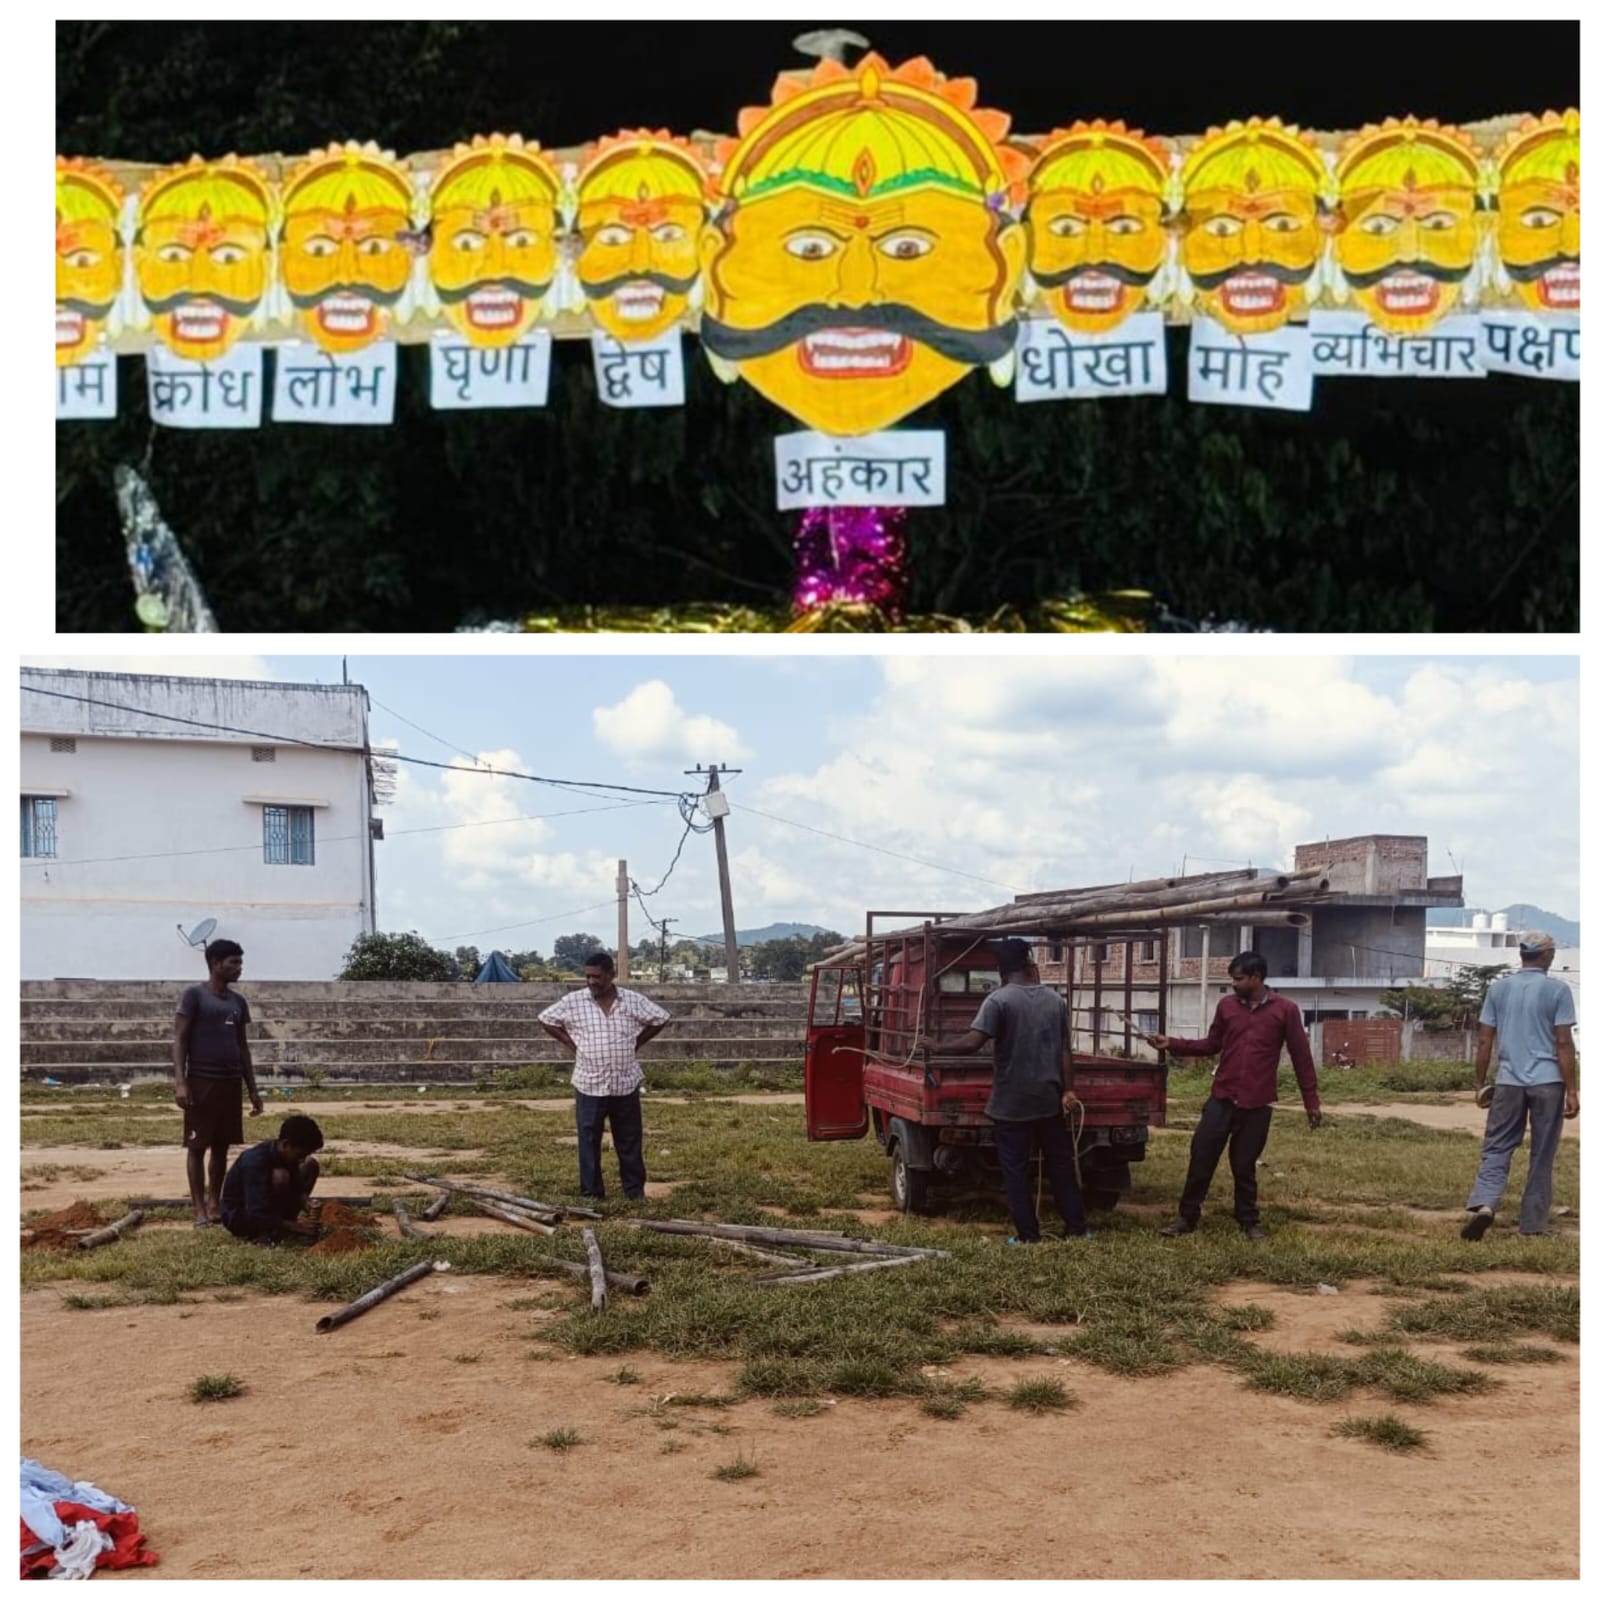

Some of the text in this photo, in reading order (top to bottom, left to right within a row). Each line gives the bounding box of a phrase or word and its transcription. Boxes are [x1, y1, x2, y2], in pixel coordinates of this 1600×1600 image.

[440, 344, 536, 400] घृणा
[598, 335, 670, 399] द्वेष
[1021, 329, 1155, 389] धोखा
[1195, 335, 1290, 400] मोह
[1310, 323, 1476, 371] व्यभिचार
[284, 351, 386, 407] लोभ
[782, 445, 931, 499] अहंकार
